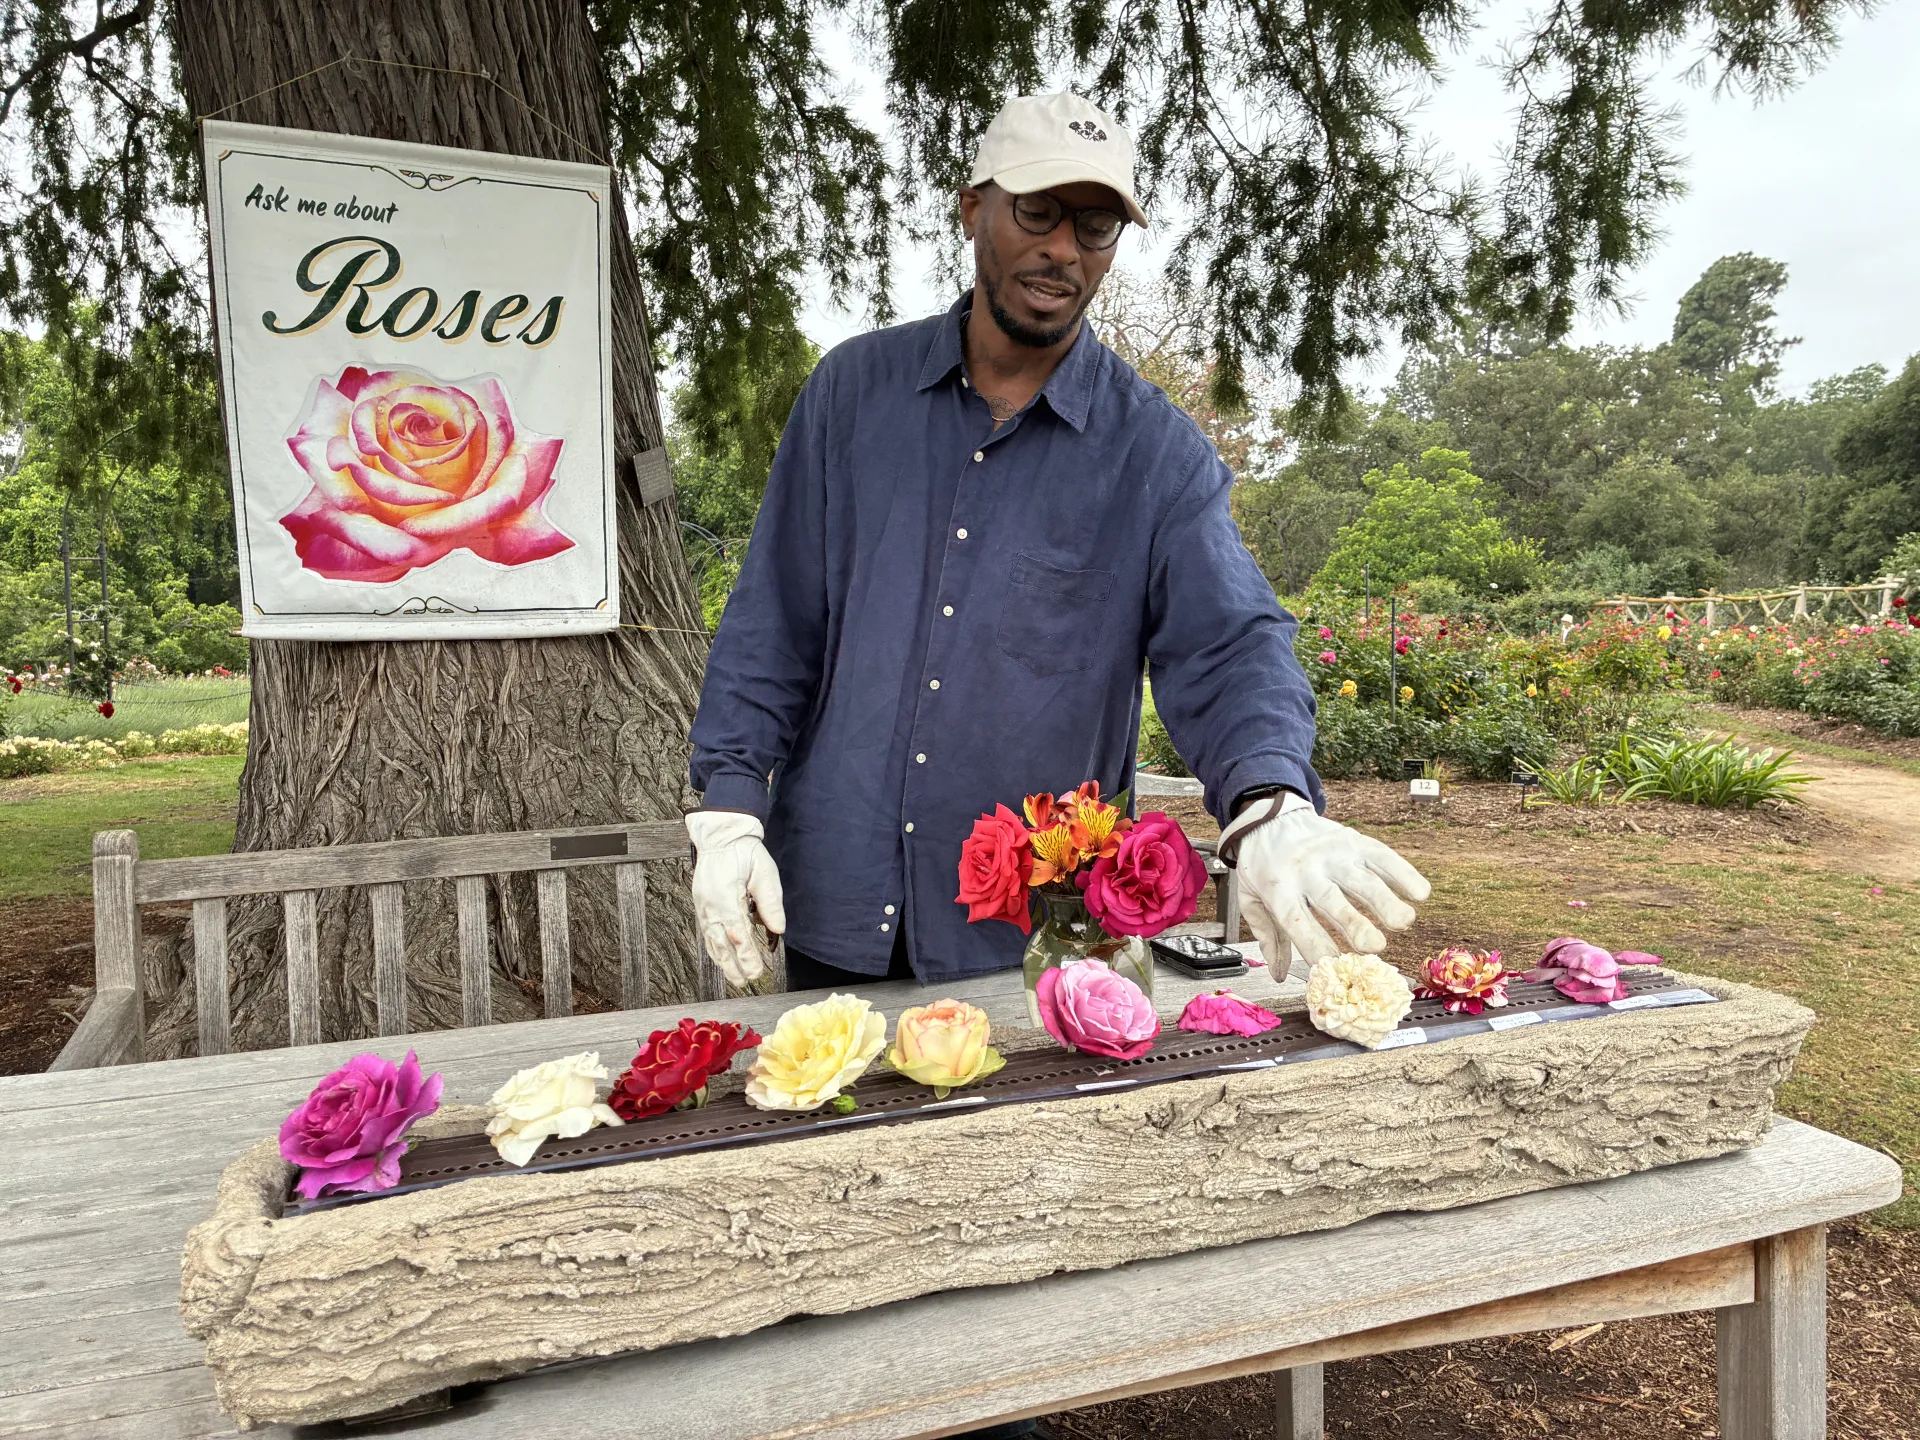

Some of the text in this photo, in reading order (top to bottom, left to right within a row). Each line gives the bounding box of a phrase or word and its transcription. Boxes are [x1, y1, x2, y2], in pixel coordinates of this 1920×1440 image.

[245, 183, 399, 223] Ask me about
[262, 236, 566, 349] Roses
[1419, 781, 1431, 790] 12
